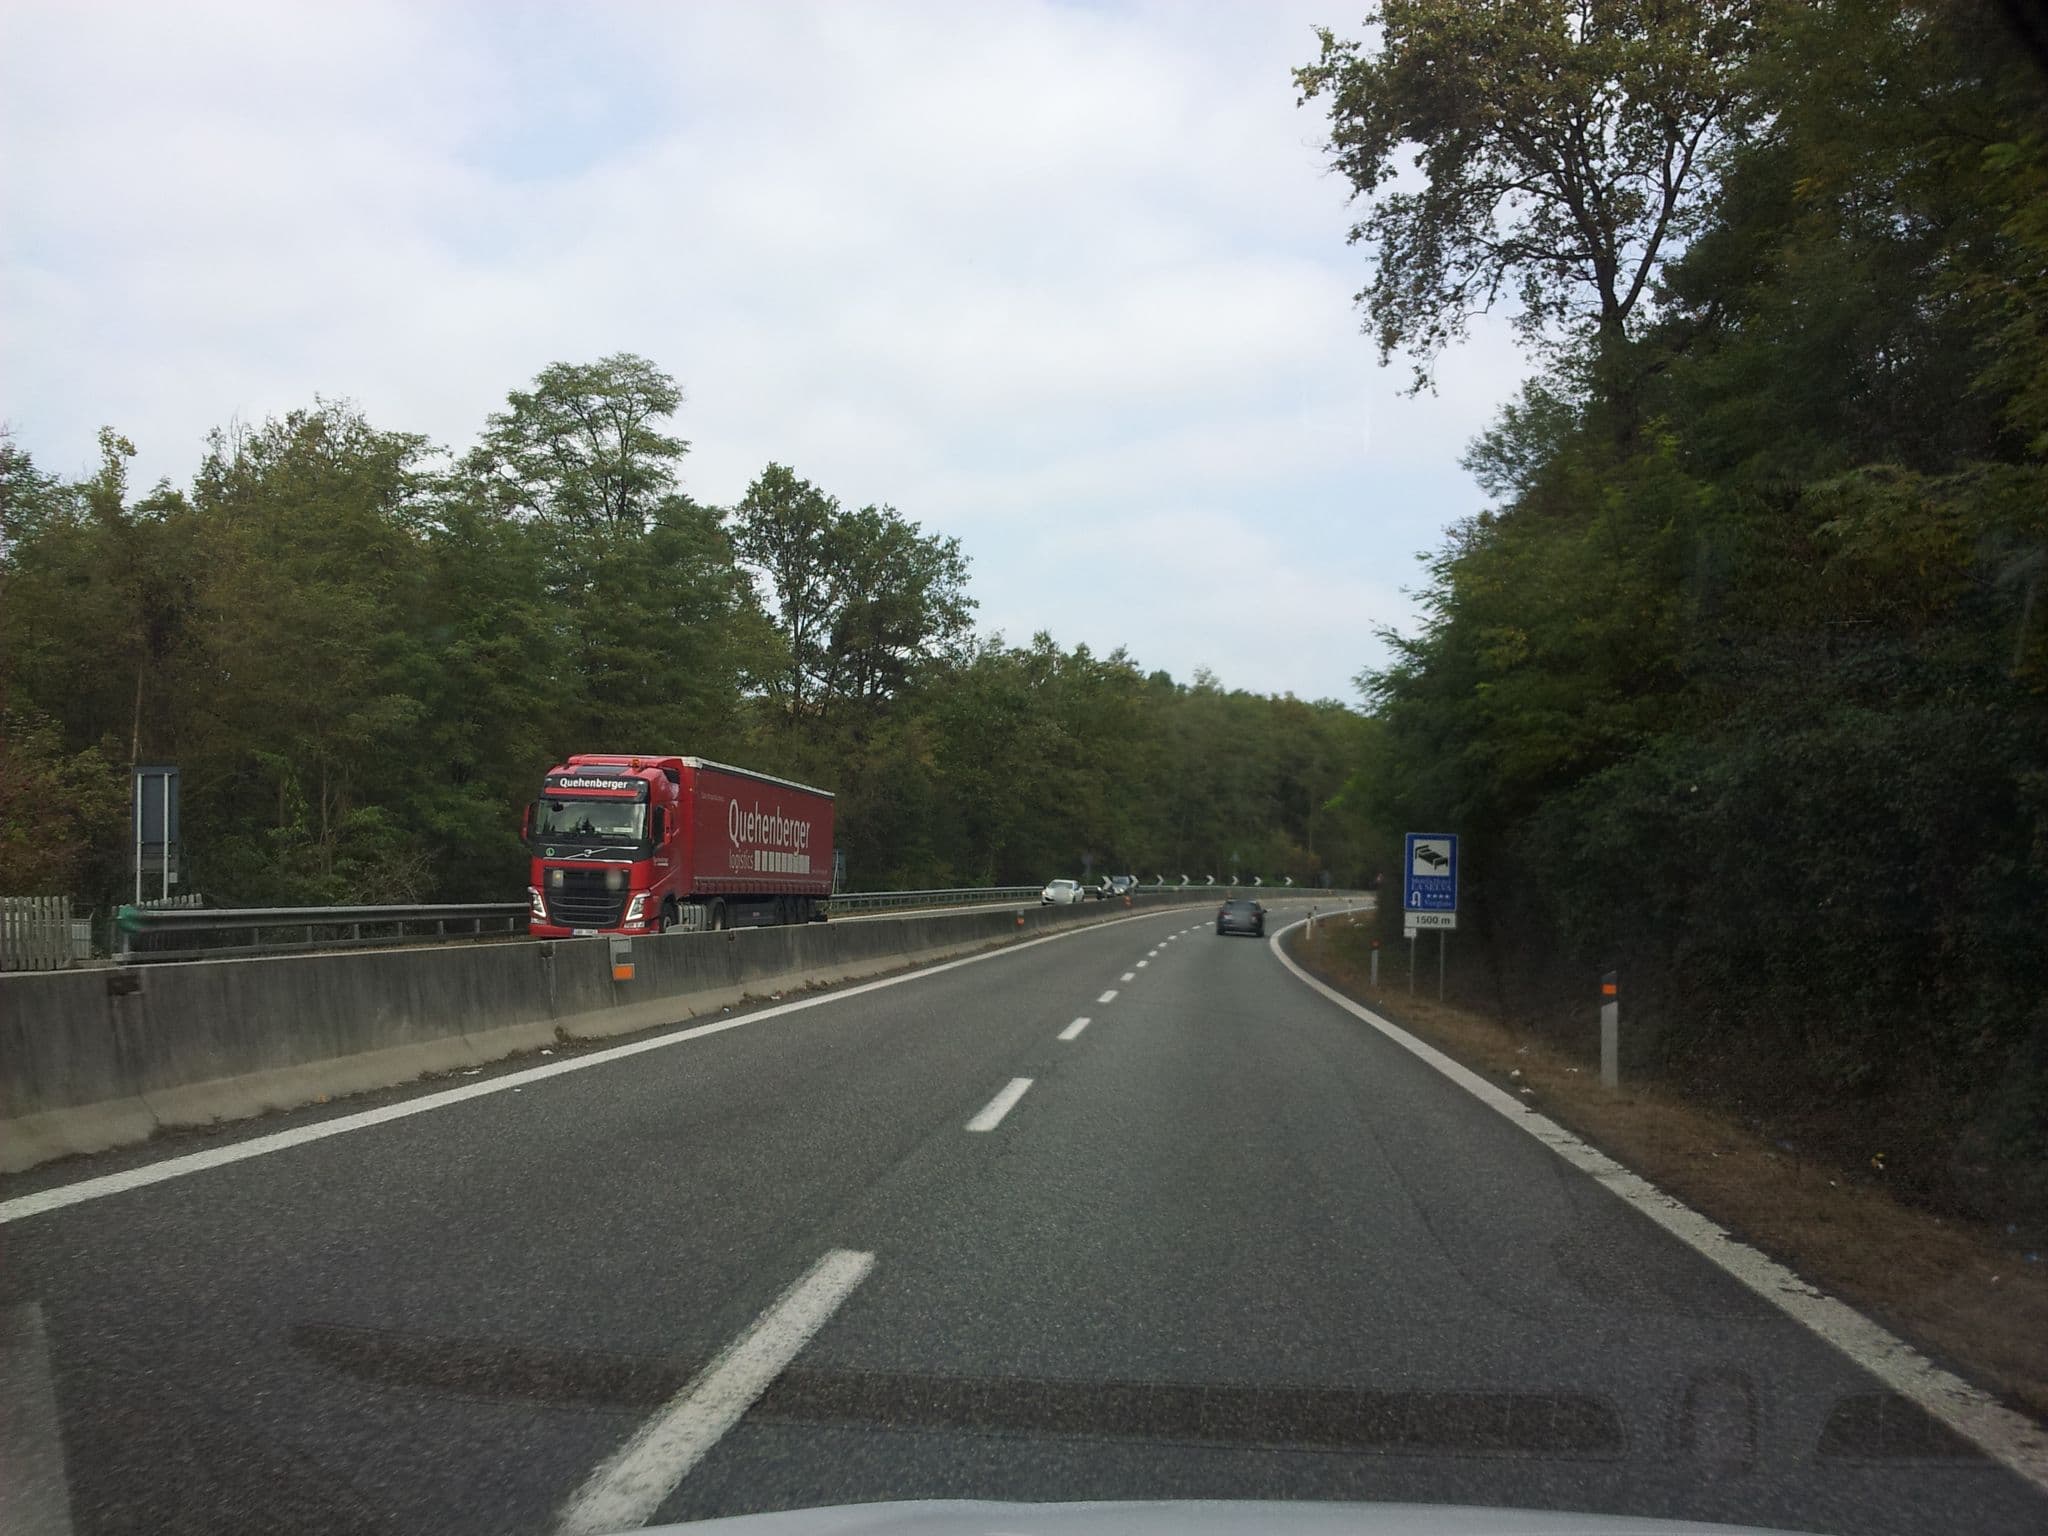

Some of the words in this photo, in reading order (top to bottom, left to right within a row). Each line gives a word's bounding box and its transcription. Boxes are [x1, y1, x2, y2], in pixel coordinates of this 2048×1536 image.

[560, 777, 628, 790] Quehenberger
[728, 798, 811, 856] Quehenberger
[1416, 915, 1439, 924] 1500
